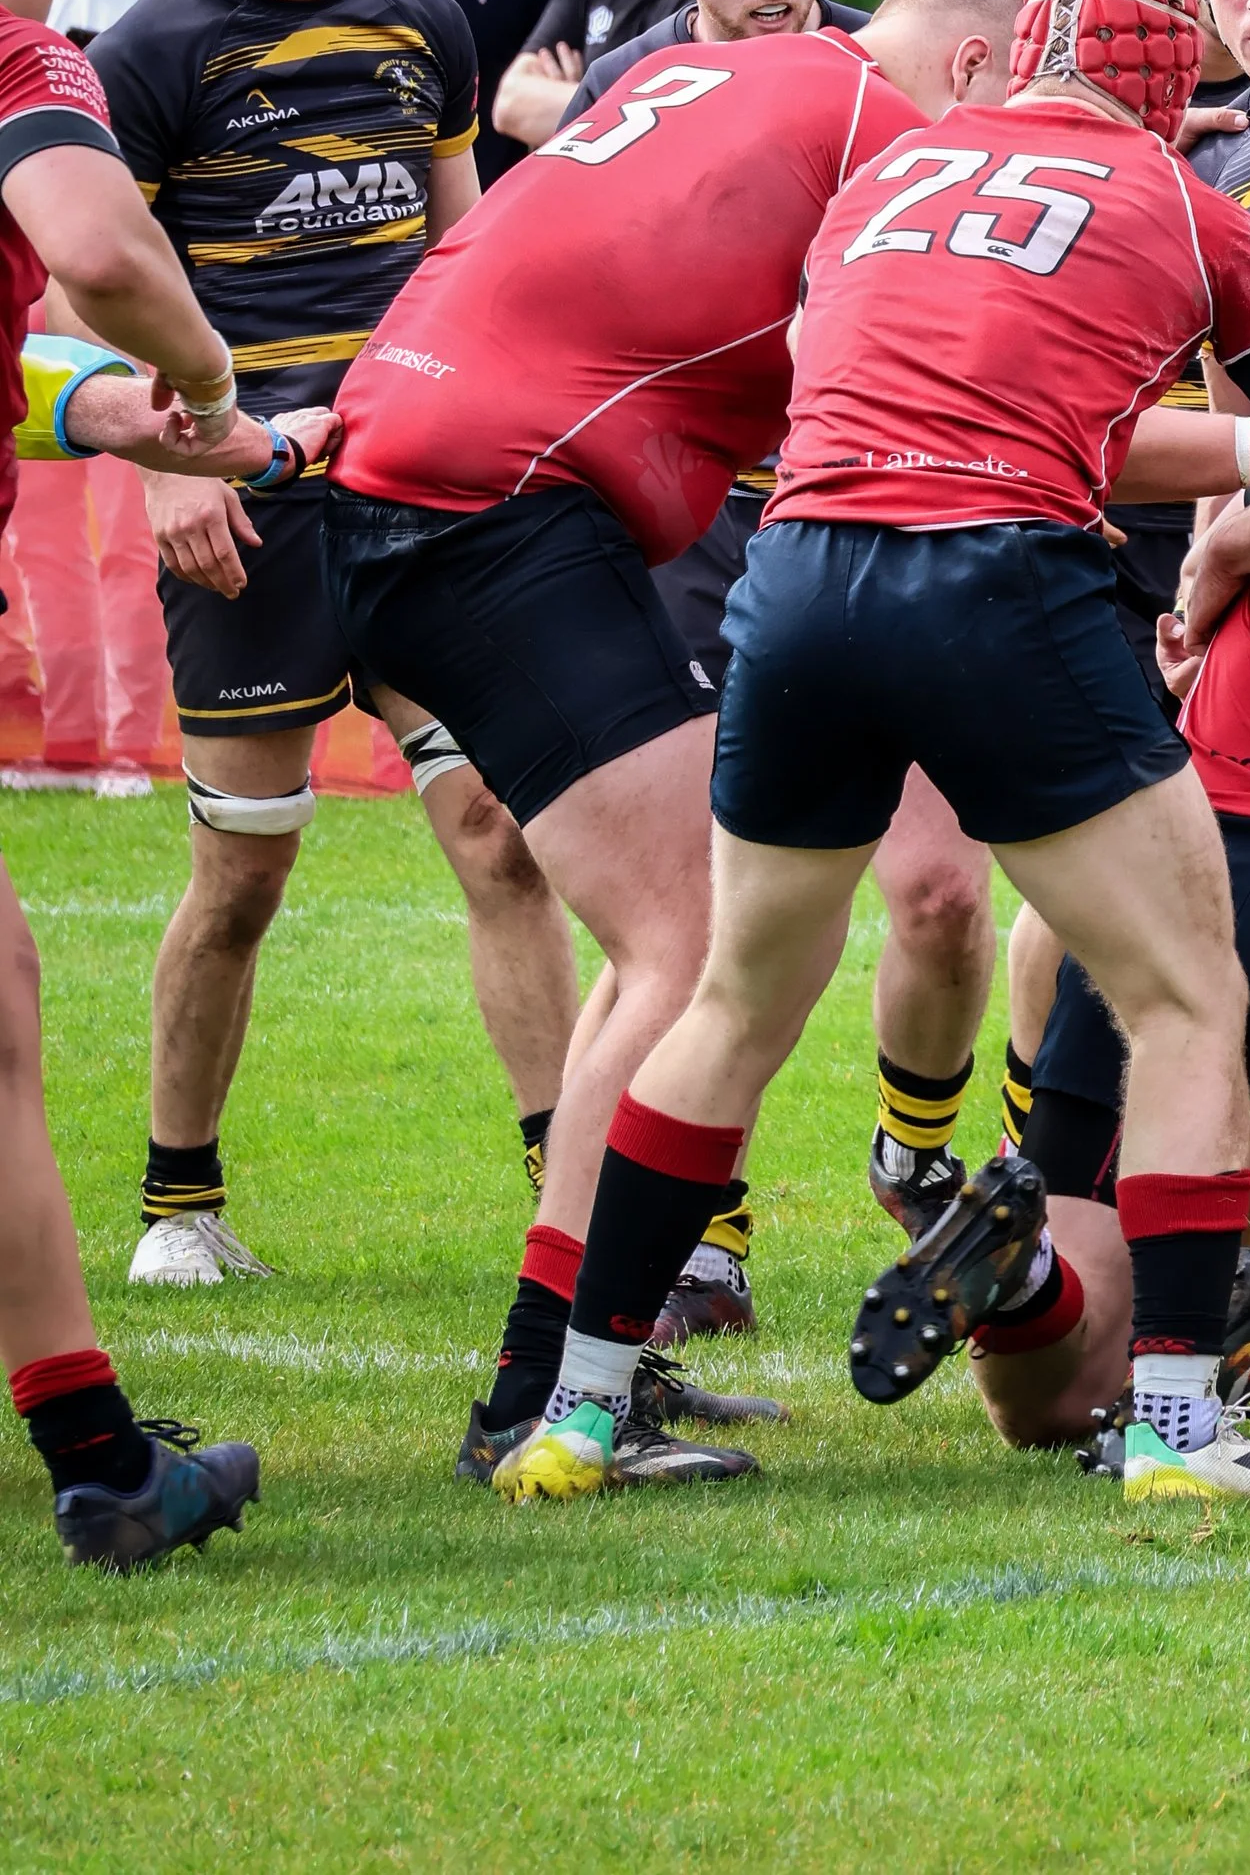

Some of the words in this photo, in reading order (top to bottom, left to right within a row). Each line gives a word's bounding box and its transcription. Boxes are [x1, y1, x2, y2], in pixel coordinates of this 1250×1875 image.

[226, 107, 300, 131] AKUMA
[535, 64, 735, 166] 3
[259, 161, 418, 218] AMA
[840, 146, 1117, 276] 25
[375, 341, 457, 380] Lancaster
[219, 682, 288, 700] AKUMA
